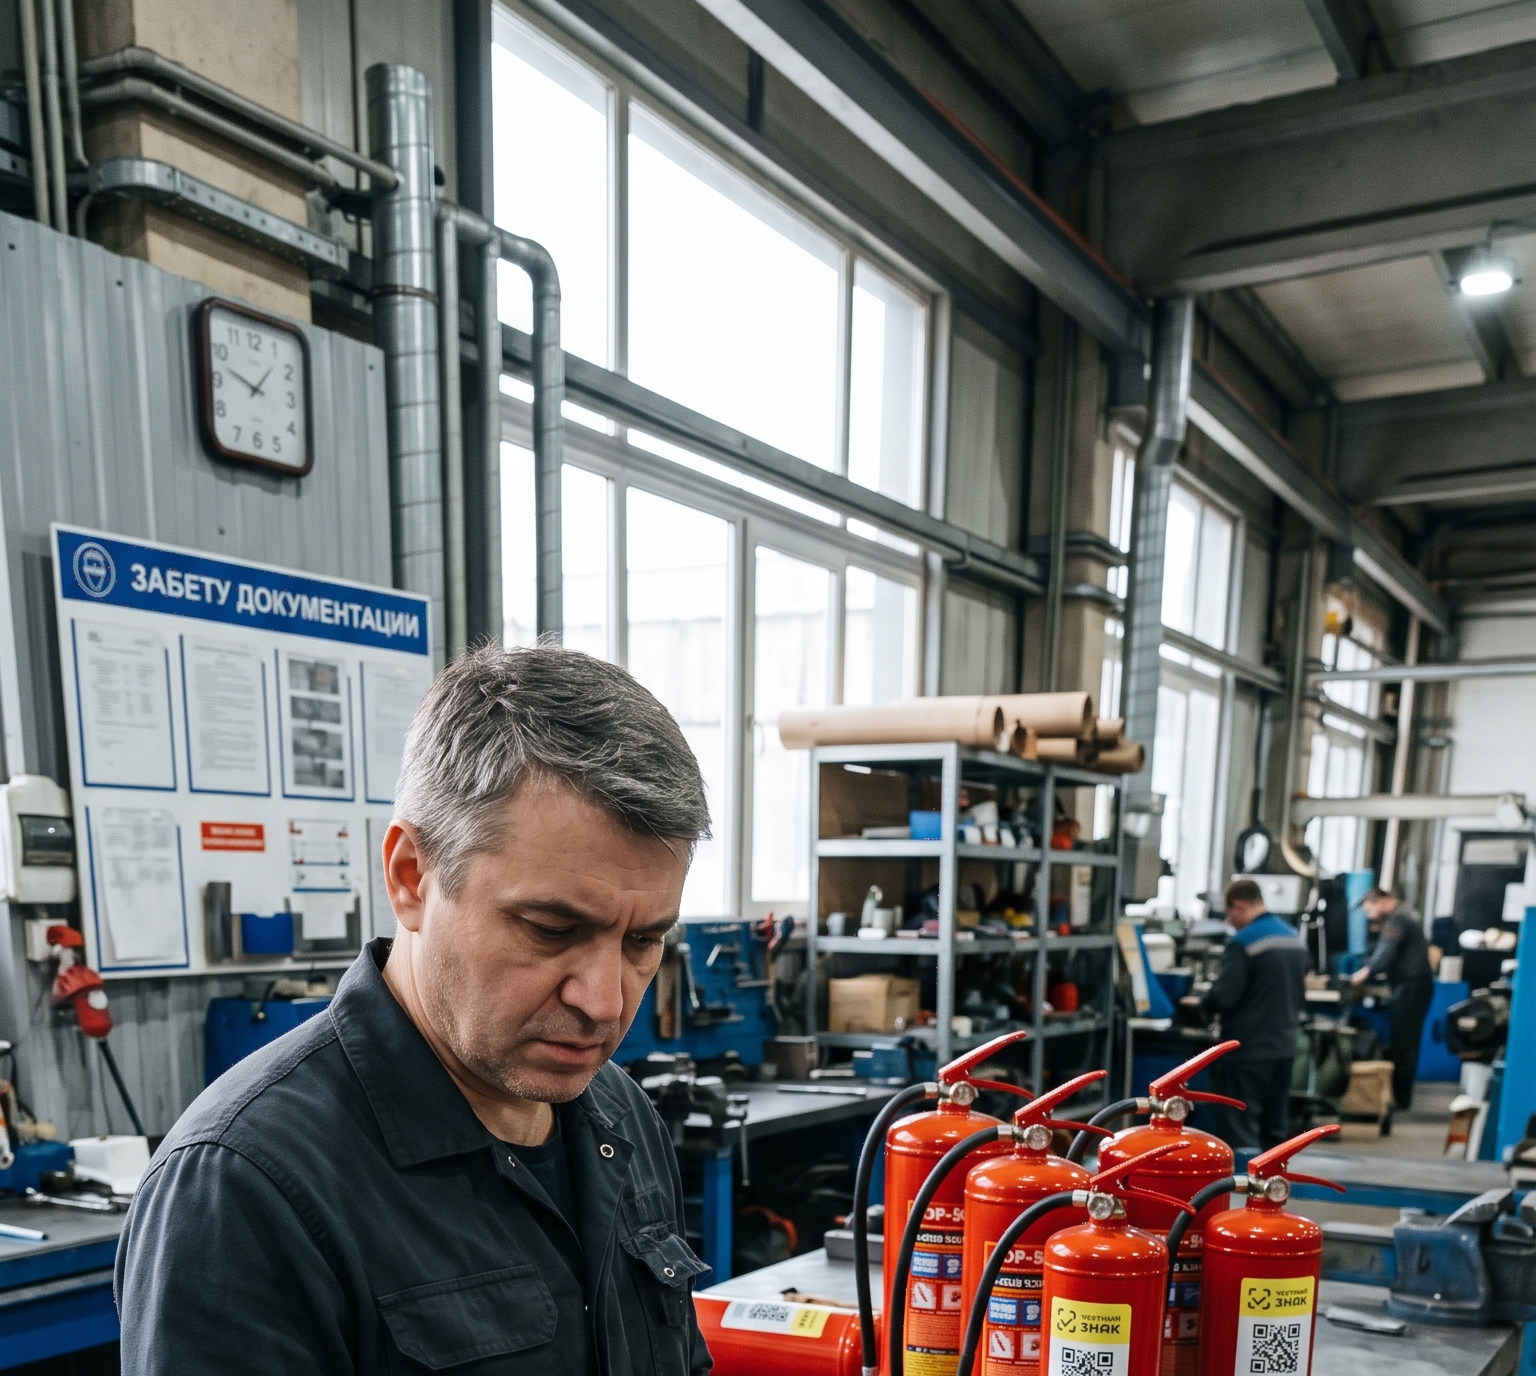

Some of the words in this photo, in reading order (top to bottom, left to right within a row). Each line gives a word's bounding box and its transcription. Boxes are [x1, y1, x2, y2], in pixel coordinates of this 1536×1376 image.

[227, 327, 240, 346] 11
[246, 331, 262, 351] 12
[212, 343, 229, 361] 10
[271, 341, 278, 358] 1
[213, 370, 223, 389] 9
[284, 364, 294, 382] 2
[215, 400, 227, 418] 8
[286, 391, 295, 409] 3
[233, 425, 242, 443] 7
[286, 421, 296, 436] 4
[253, 431, 263, 450] 6
[272, 435, 282, 453] 5
[130, 563, 232, 606] ЗАБЕТУ
[236, 583, 419, 638] ДОКУМЕНТАЦИИ
[1275, 1296, 1307, 1308] ЗНАК
[1080, 1322, 1120, 1334] ЗНАК
